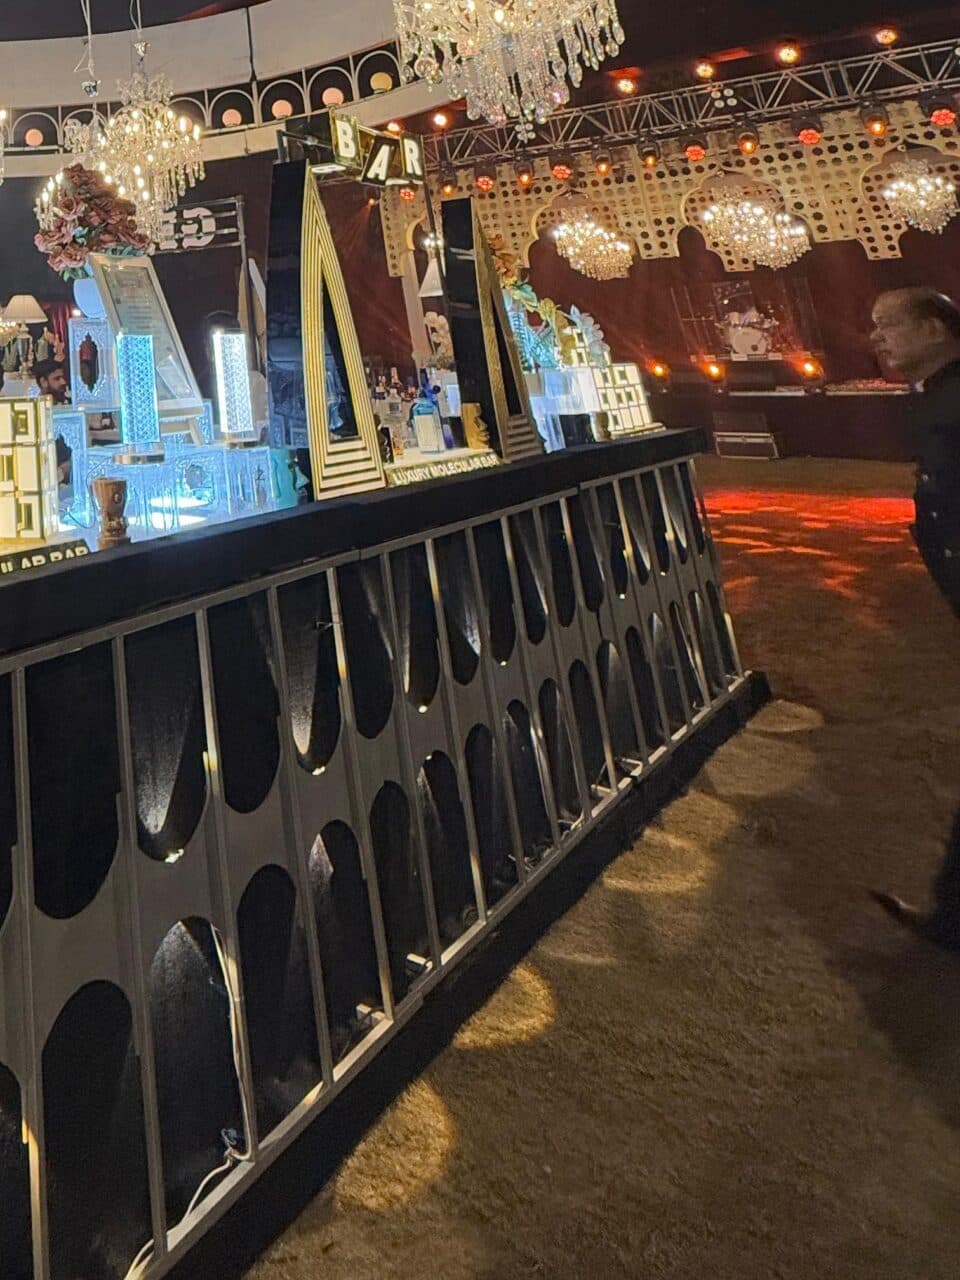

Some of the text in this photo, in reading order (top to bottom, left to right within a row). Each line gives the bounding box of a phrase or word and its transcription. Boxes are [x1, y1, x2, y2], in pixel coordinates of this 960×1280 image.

[335, 119, 423, 181] BAR
[392, 466, 431, 486] LUXURY
[480, 453, 500, 470] BAR
